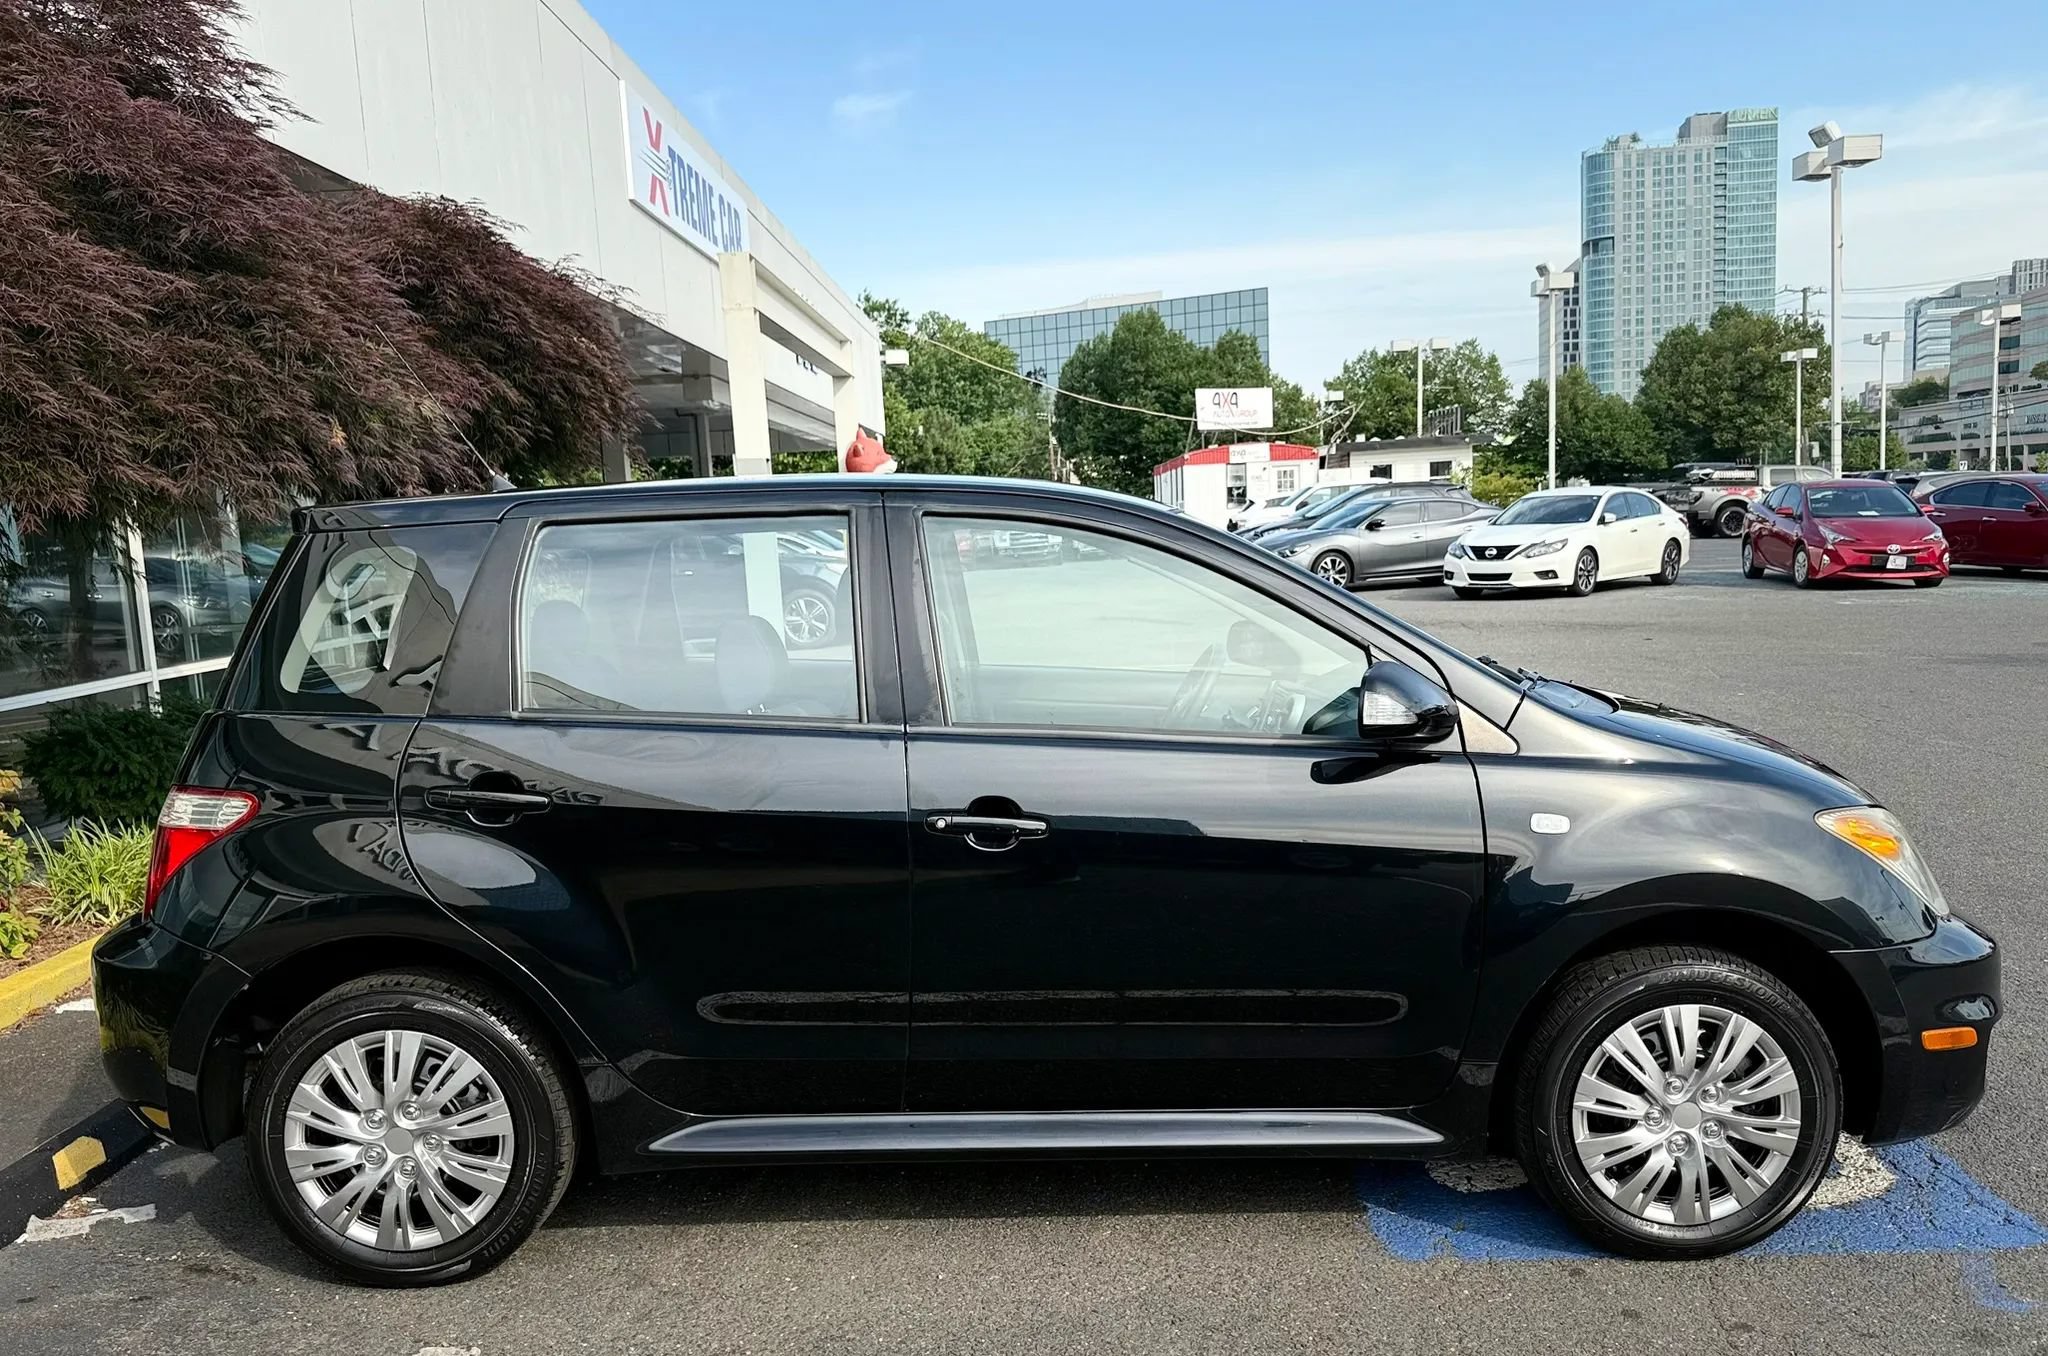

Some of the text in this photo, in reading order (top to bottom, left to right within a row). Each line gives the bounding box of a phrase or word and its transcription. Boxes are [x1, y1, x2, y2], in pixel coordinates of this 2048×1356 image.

[1728, 106, 1779, 121] LUMEN
[719, 193, 743, 253] CAR
[1659, 967, 1793, 1011] BRIDGESTONE
